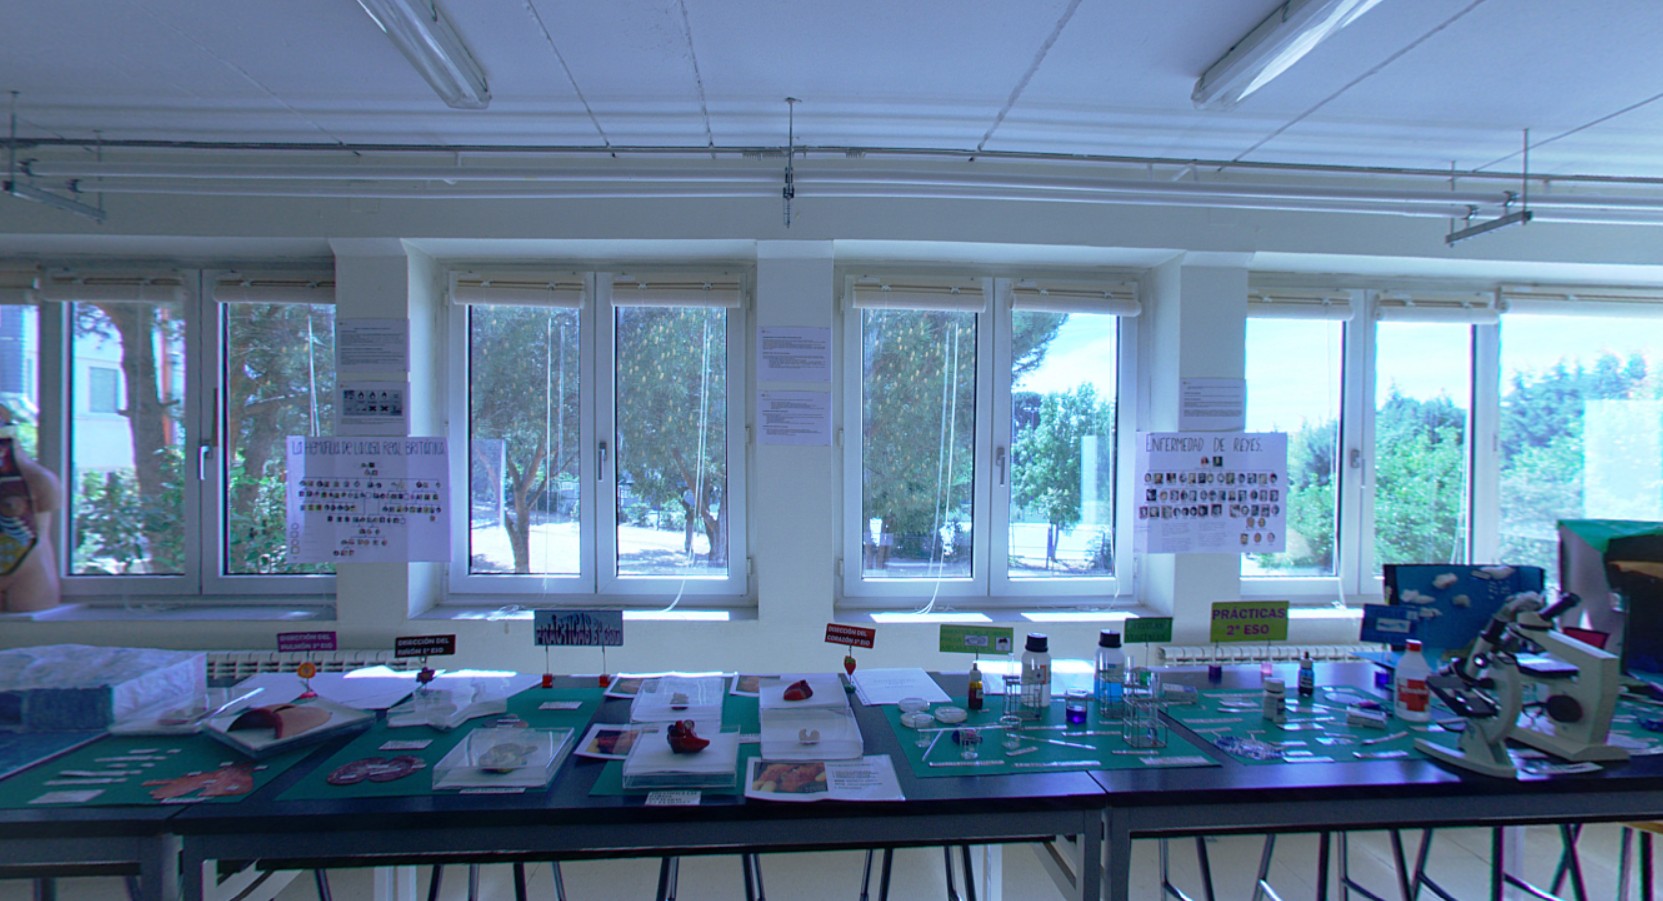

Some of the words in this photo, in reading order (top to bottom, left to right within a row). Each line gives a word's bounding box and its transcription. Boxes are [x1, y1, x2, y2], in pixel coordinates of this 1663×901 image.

[1146, 433, 1204, 453] ENFERMEDAD
[1213, 437, 1225, 452] DE
[1212, 606, 1286, 620] PRÁCTICAS
[1244, 624, 1270, 635] ESO
